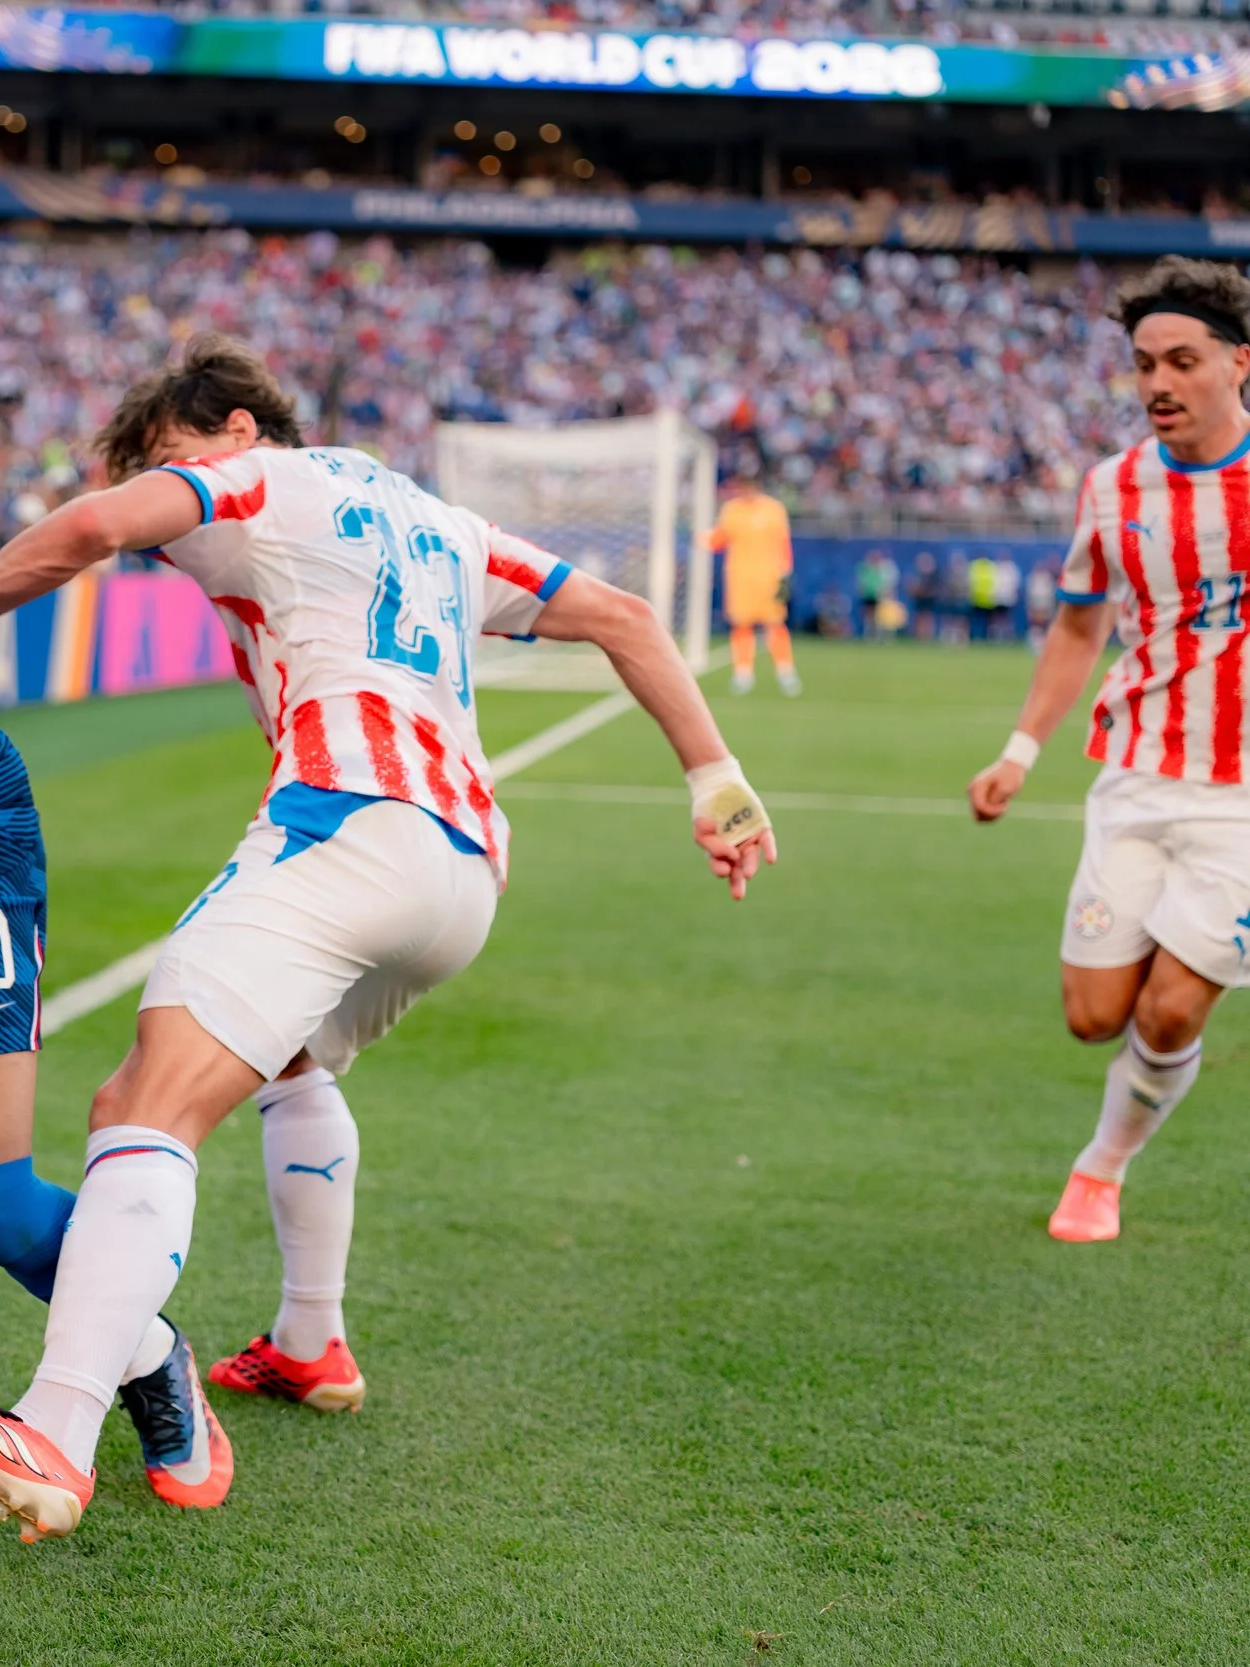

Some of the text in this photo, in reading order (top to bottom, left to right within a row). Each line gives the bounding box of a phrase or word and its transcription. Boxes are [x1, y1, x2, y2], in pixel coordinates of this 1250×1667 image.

[443, 26, 641, 86] WORLD
[642, 34, 748, 88] CUP
[751, 38, 943, 98] 2026
[333, 496, 472, 711] 23
[1190, 573, 1245, 631] 11
